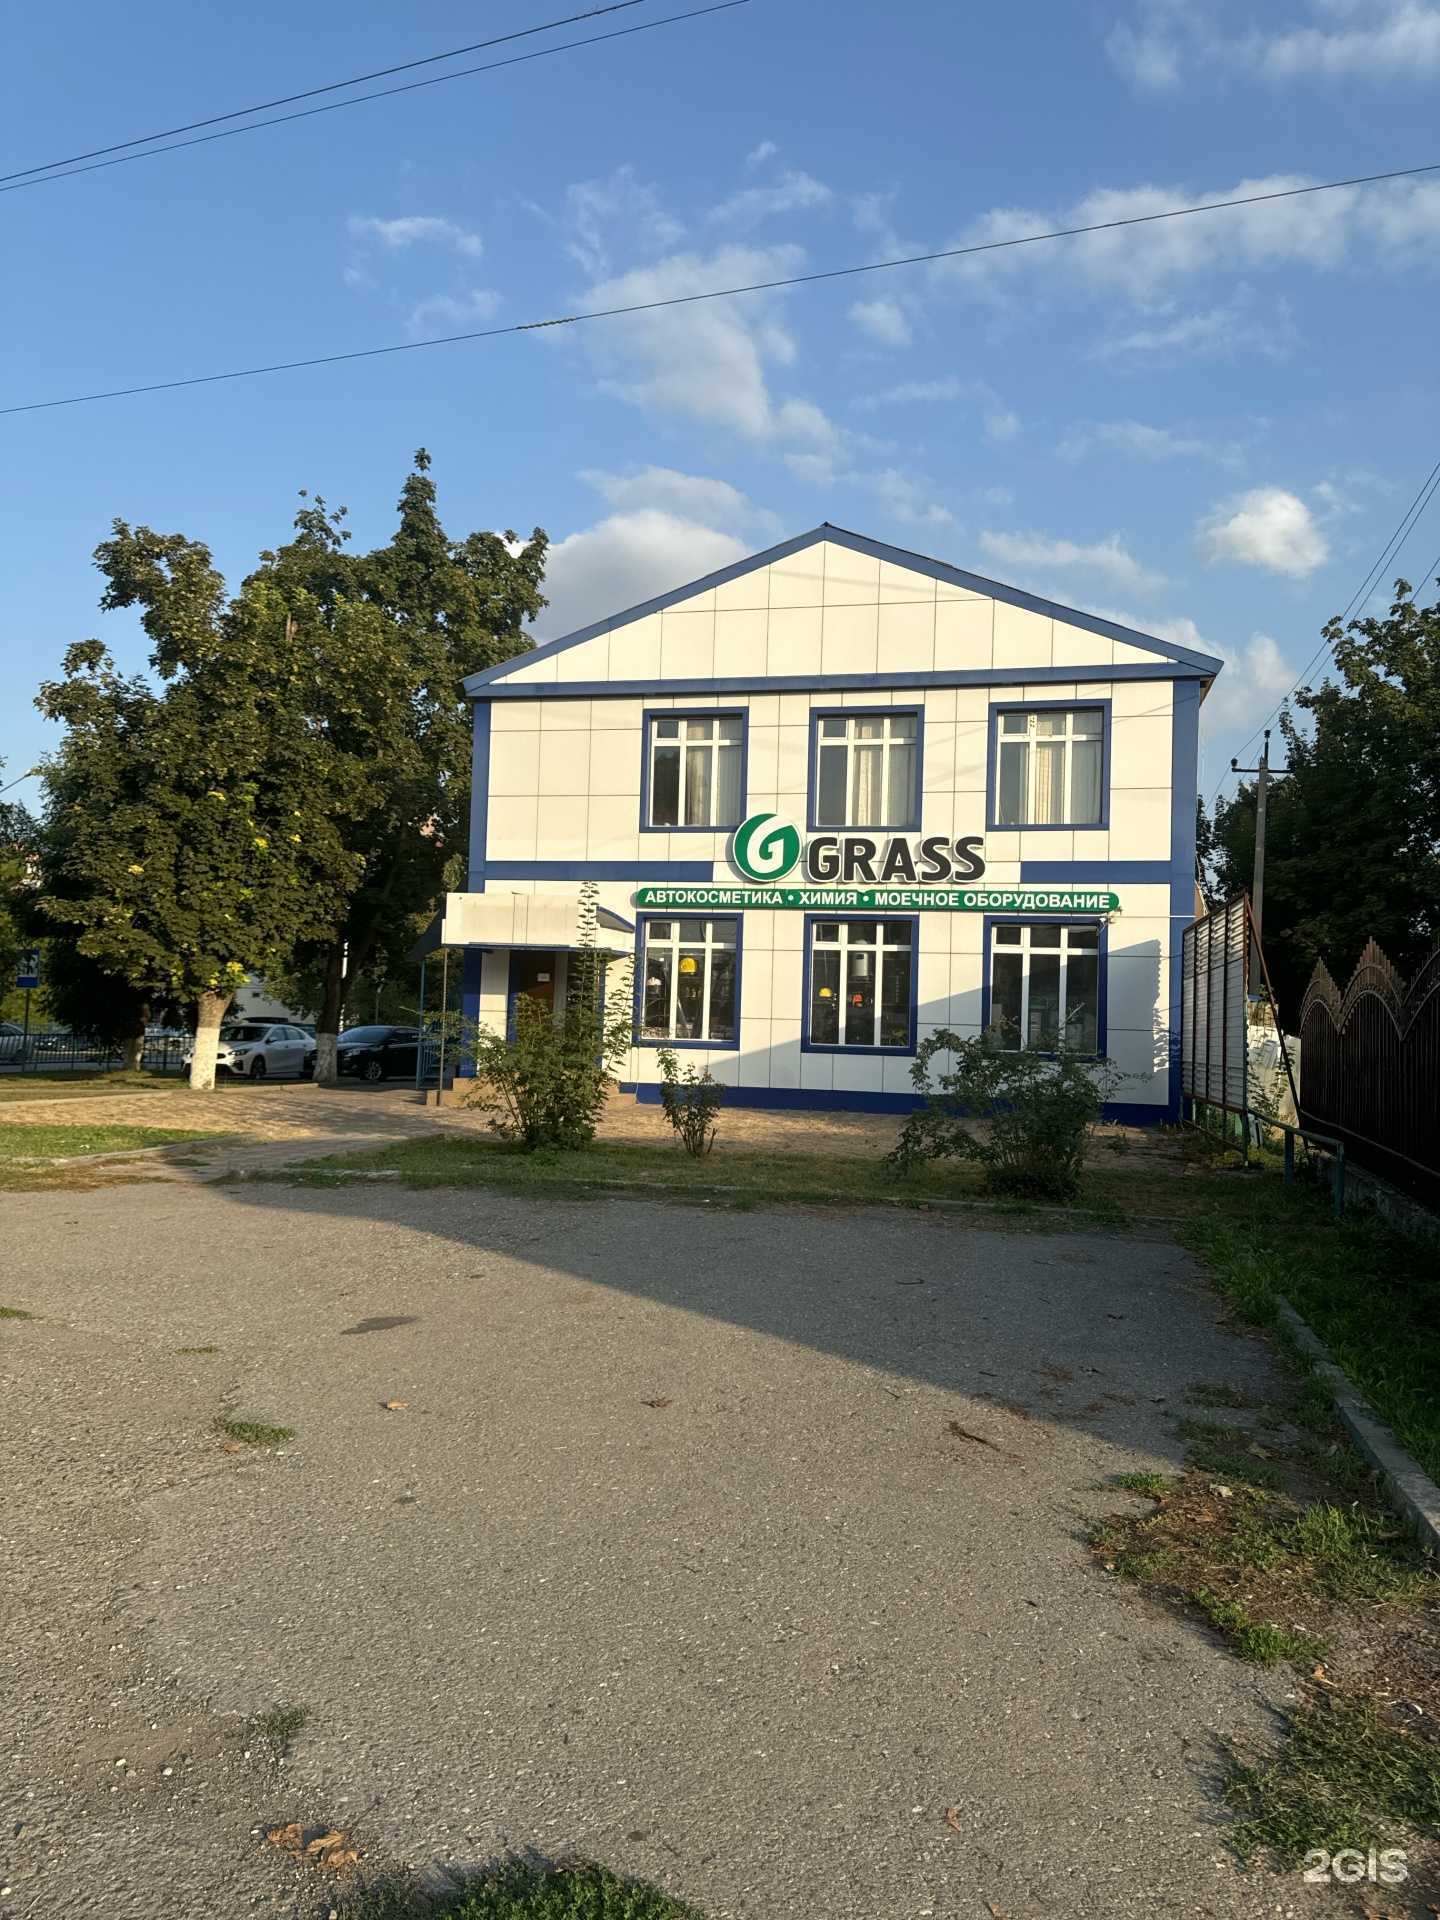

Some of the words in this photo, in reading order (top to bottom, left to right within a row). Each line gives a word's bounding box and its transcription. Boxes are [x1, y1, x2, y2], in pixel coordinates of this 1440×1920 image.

[808, 836, 986, 883] GRASS
[645, 890, 783, 904] АВТОКОСМЕТИКА
[799, 892, 857, 905] ХИМИЯ
[875, 892, 960, 907] МОЕЧНОЕ
[963, 893, 1110, 909] ОБОРУДОВАНИЕ
